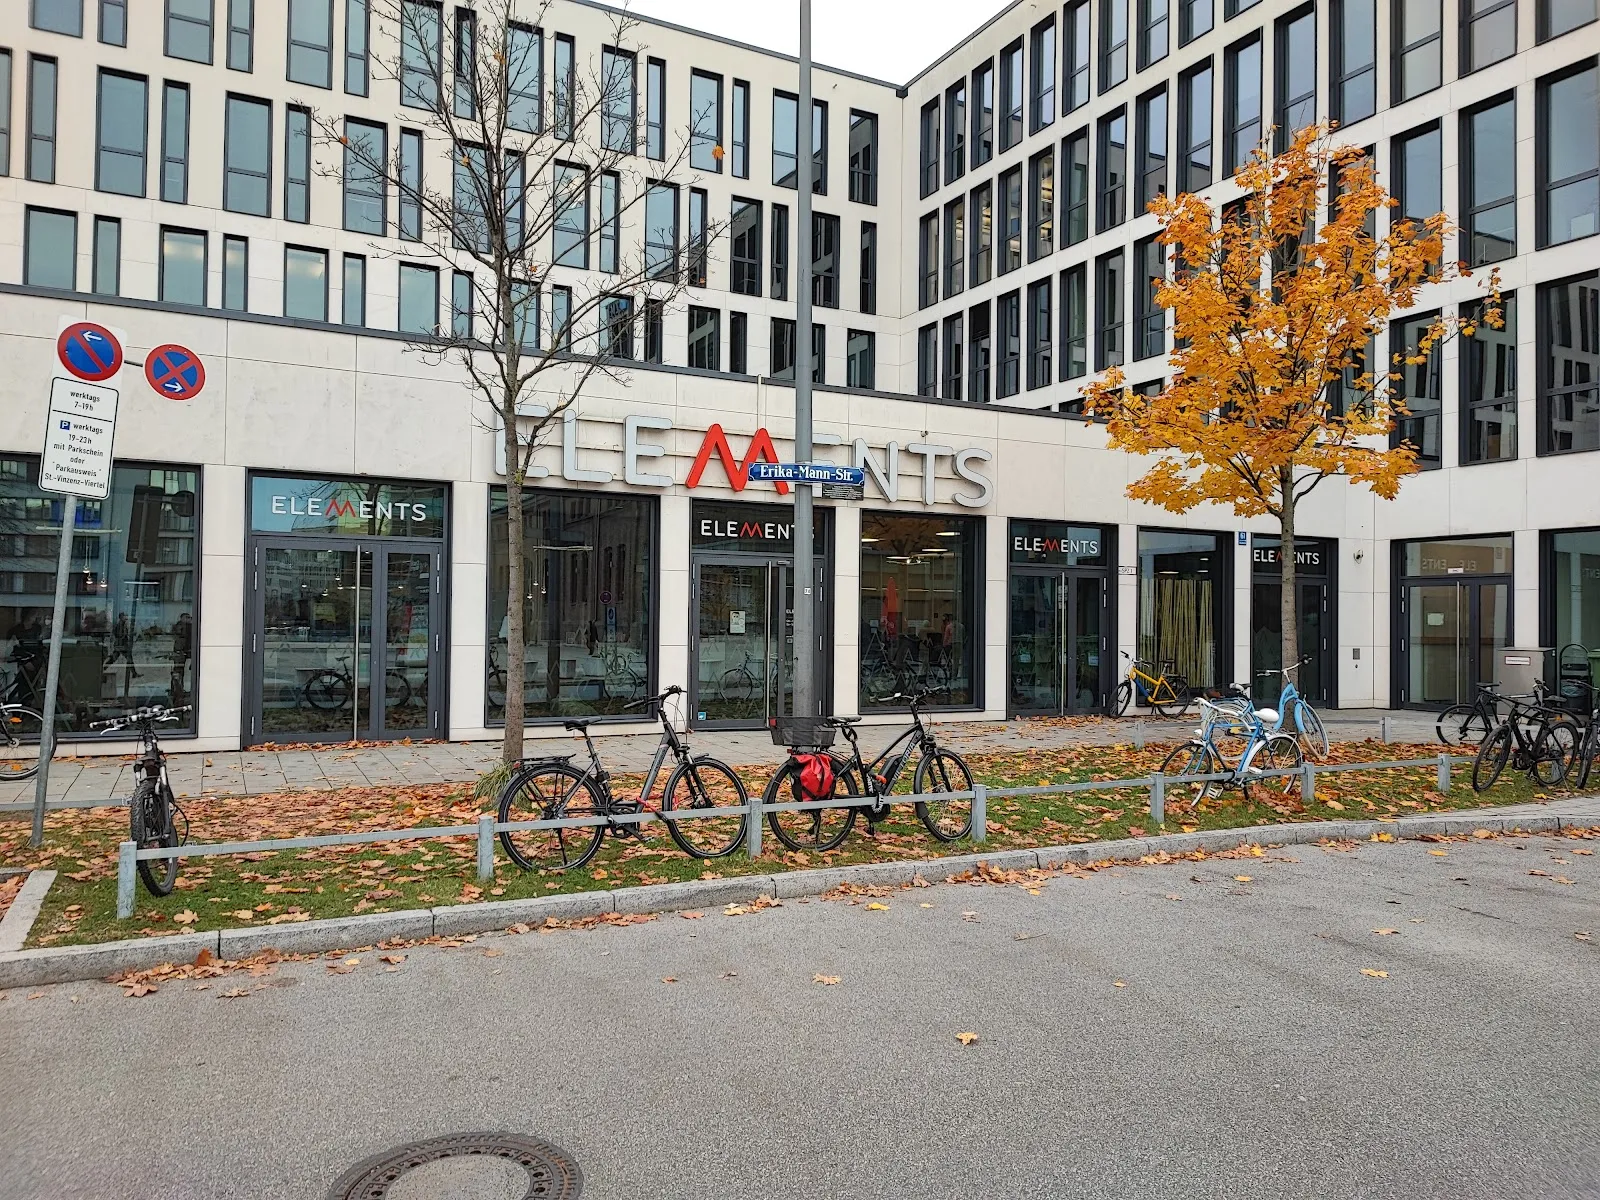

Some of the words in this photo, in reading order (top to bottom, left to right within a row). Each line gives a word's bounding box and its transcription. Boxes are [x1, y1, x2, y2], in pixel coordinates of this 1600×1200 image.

[70, 390, 101, 403] werktags
[73, 423, 104, 435] werktags
[53, 443, 65, 451] mit
[67, 444, 104, 457] Parkschein
[70, 456, 85, 465] oder
[44, 473, 105, 489] St.-Vinzenz-Viertel
[760, 464, 854, 482] Erika-Mann-Str.
[272, 495, 427, 522] ELEMENTS
[700, 519, 814, 540] ELEMEN
[1014, 537, 1098, 555] ELEMENTS
